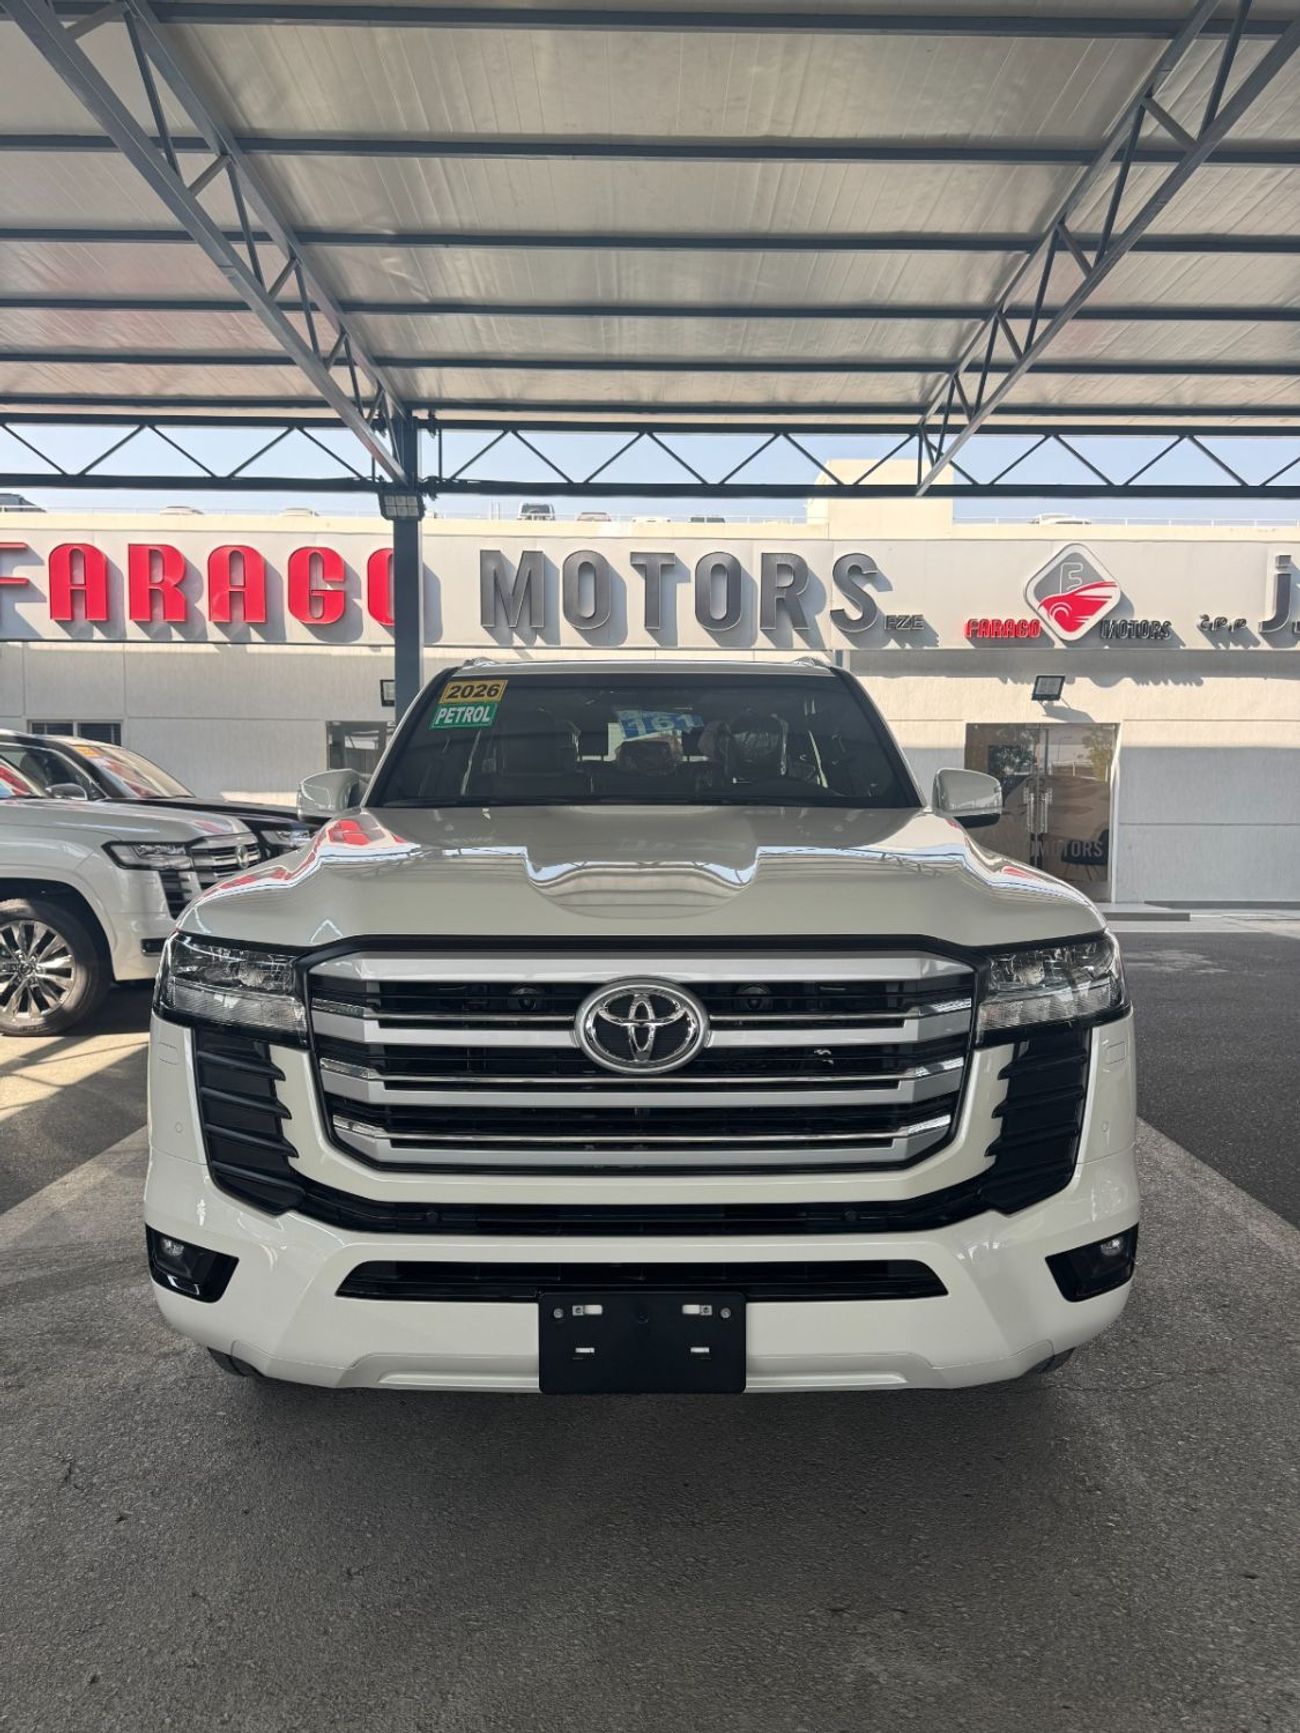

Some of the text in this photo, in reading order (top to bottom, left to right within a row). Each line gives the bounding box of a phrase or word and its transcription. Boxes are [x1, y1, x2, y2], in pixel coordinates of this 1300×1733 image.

[479, 549, 879, 633] MOTORS
[883, 614, 925, 630] FZE
[964, 618, 1172, 640] FARAGO MOTORS
[446, 684, 500, 698] 2026
[435, 706, 490, 724] PETROL
